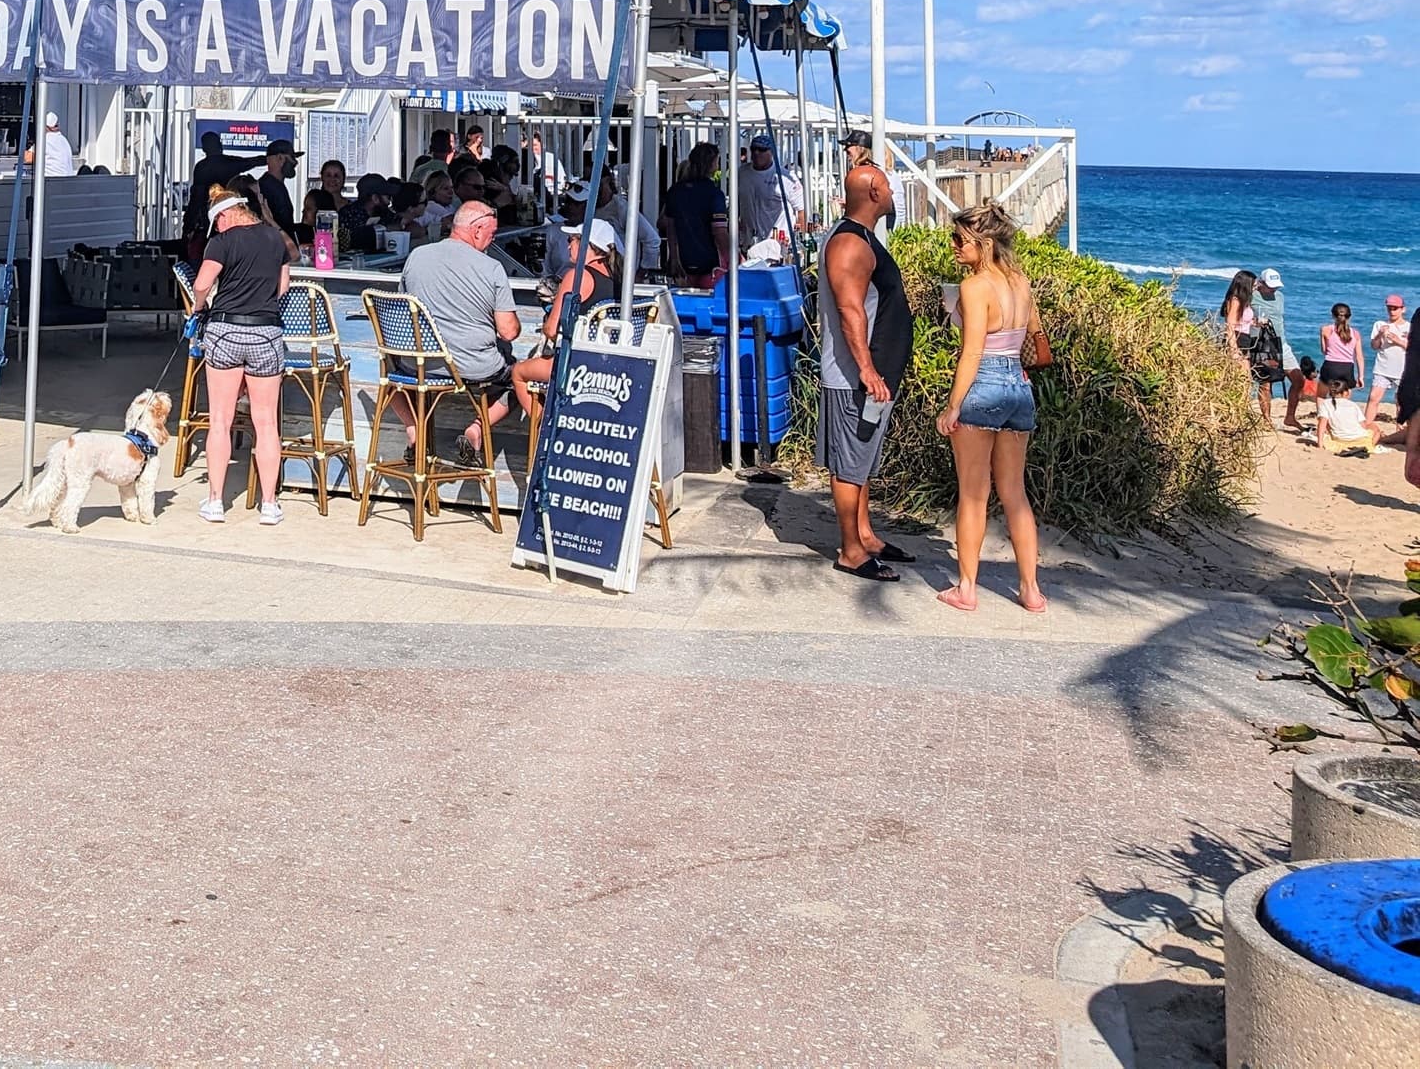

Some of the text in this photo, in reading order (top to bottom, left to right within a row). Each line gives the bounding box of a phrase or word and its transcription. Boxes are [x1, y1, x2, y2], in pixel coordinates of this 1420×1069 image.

[401, 97, 443, 109] FRONT DESK
[566, 364, 632, 402] Benny's
[548, 415, 638, 440] BSOLUTELY
[566, 443, 631, 467] ALCOHOL
[546, 465, 627, 494] LLOWED ON
[533, 489, 623, 521] TE BEACH!!!
